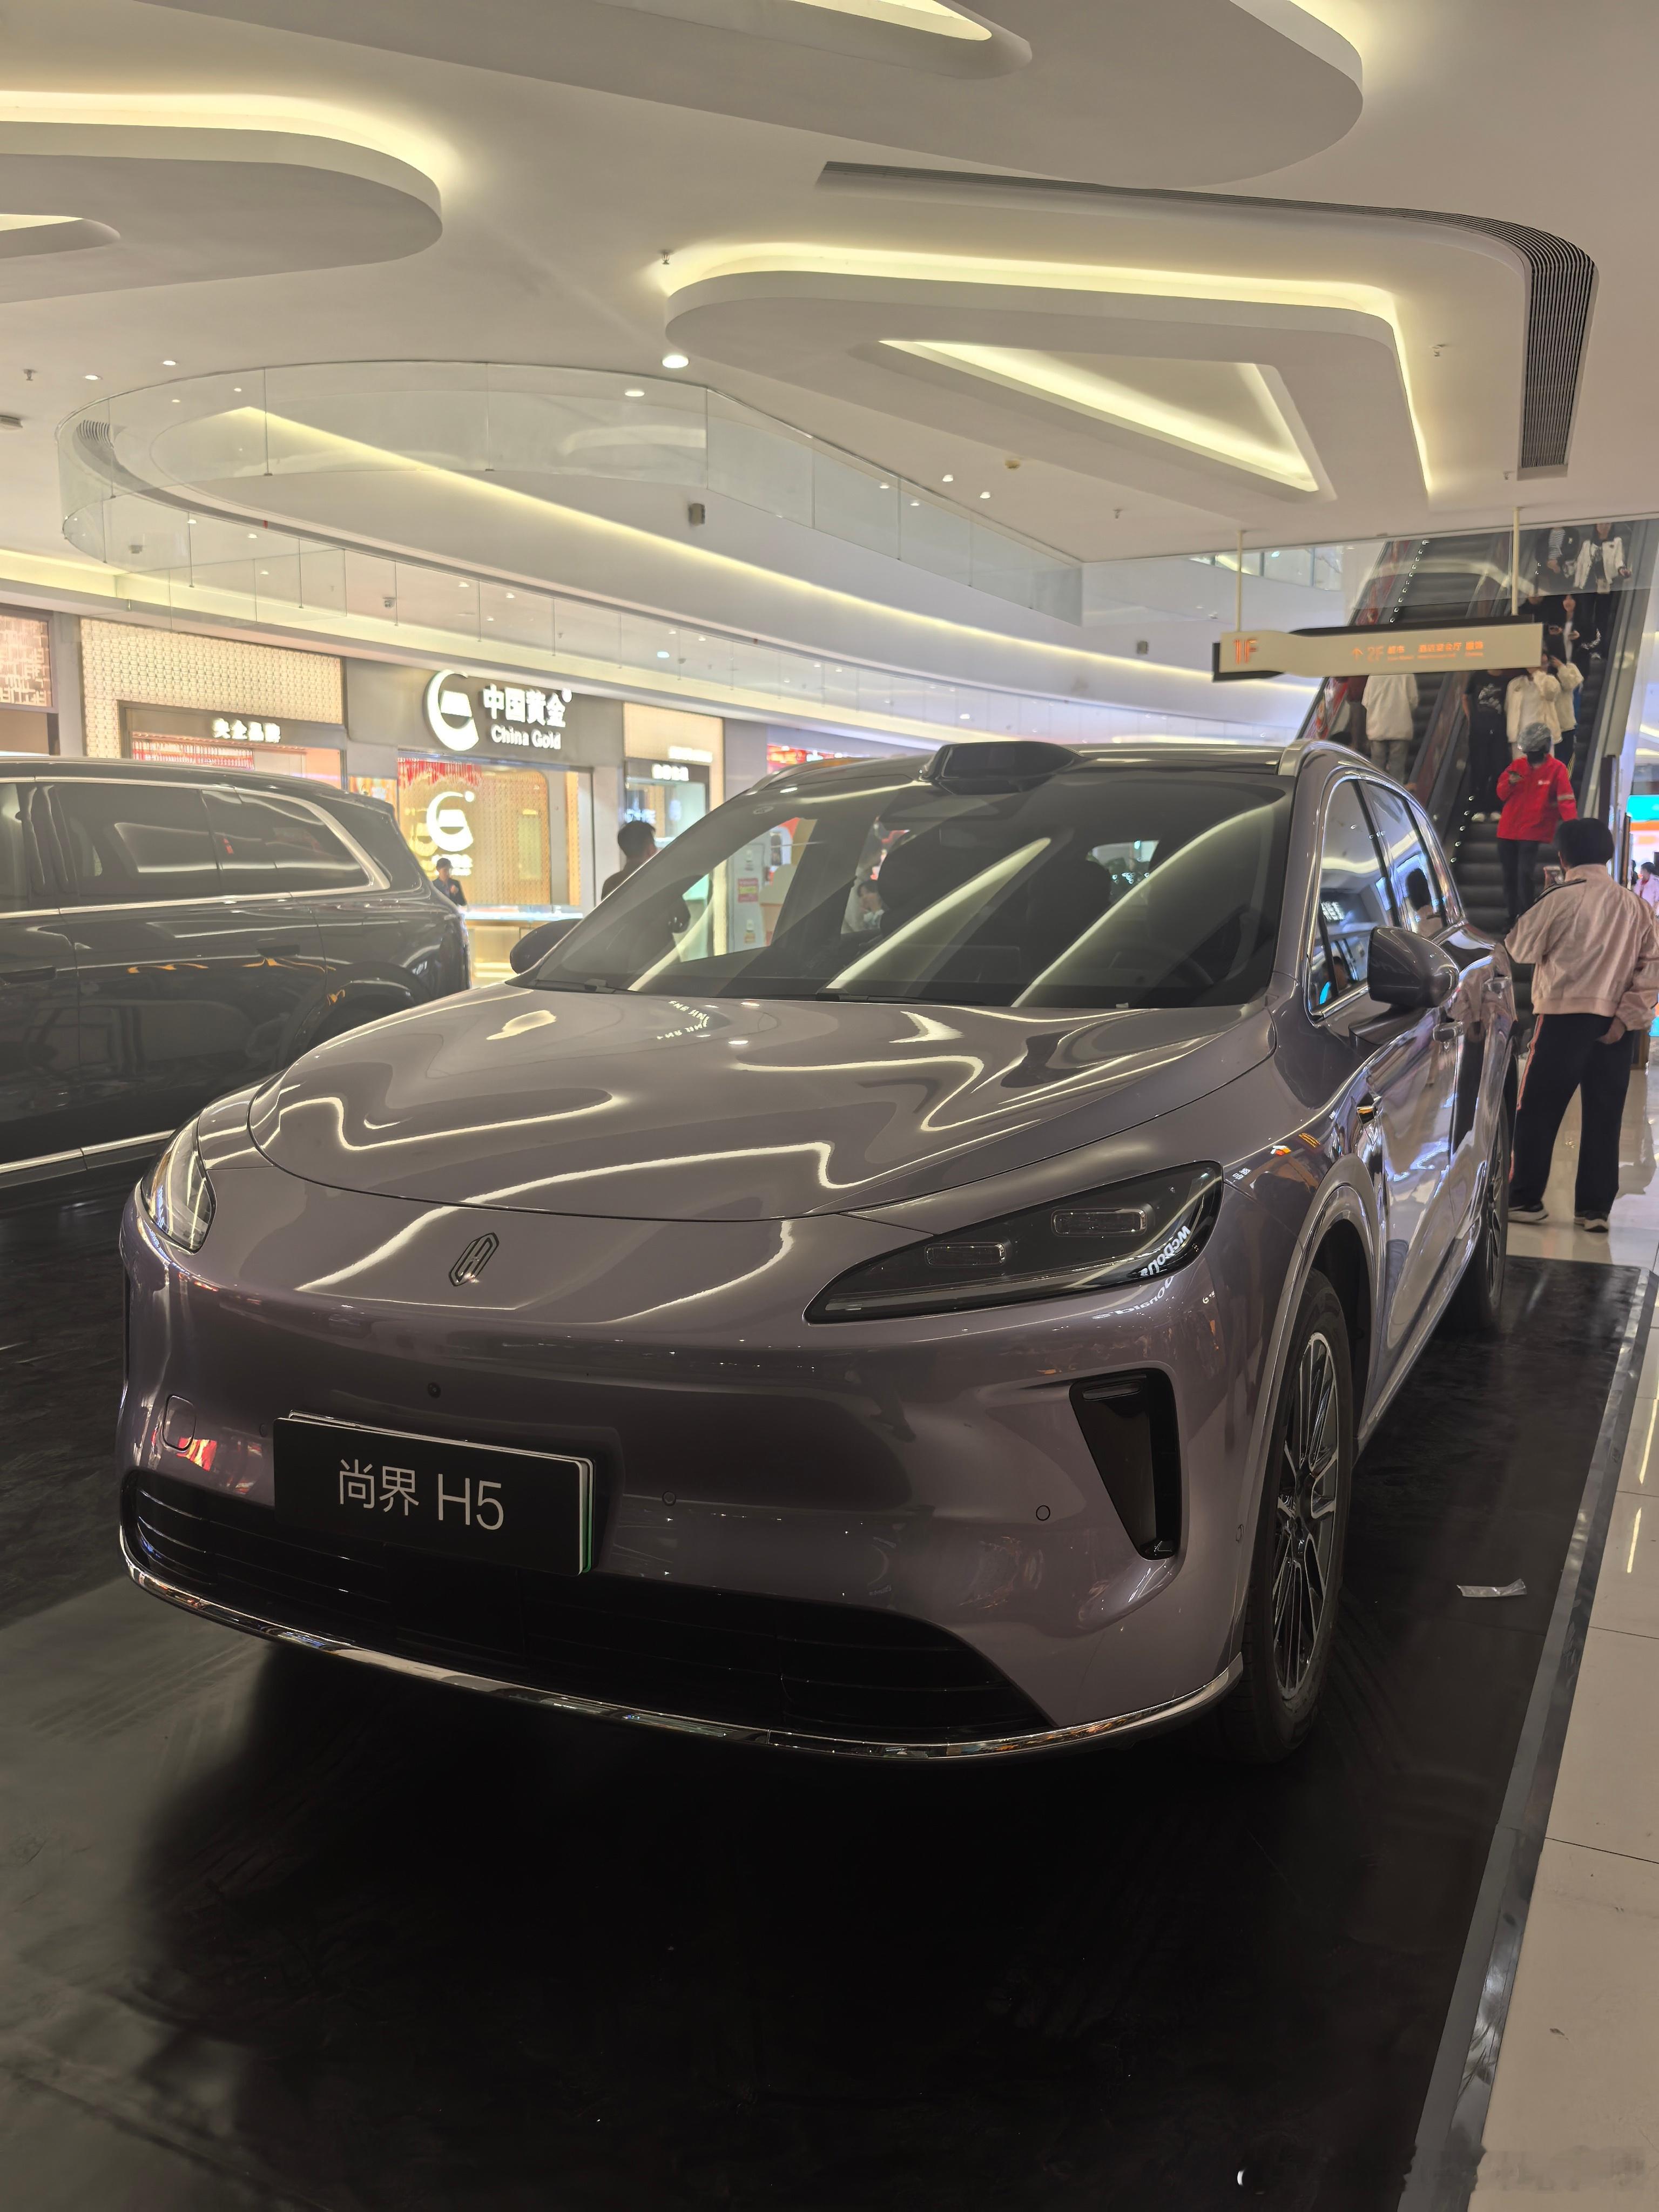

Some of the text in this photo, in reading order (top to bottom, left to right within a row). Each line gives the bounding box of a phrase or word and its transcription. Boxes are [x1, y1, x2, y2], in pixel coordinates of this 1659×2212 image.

[1233, 639, 1258, 665] 1F
[482, 683, 566, 727] 中国黄金
[491, 724, 562, 750] China Gold
[340, 1459, 504, 1530] 尚界 H5
